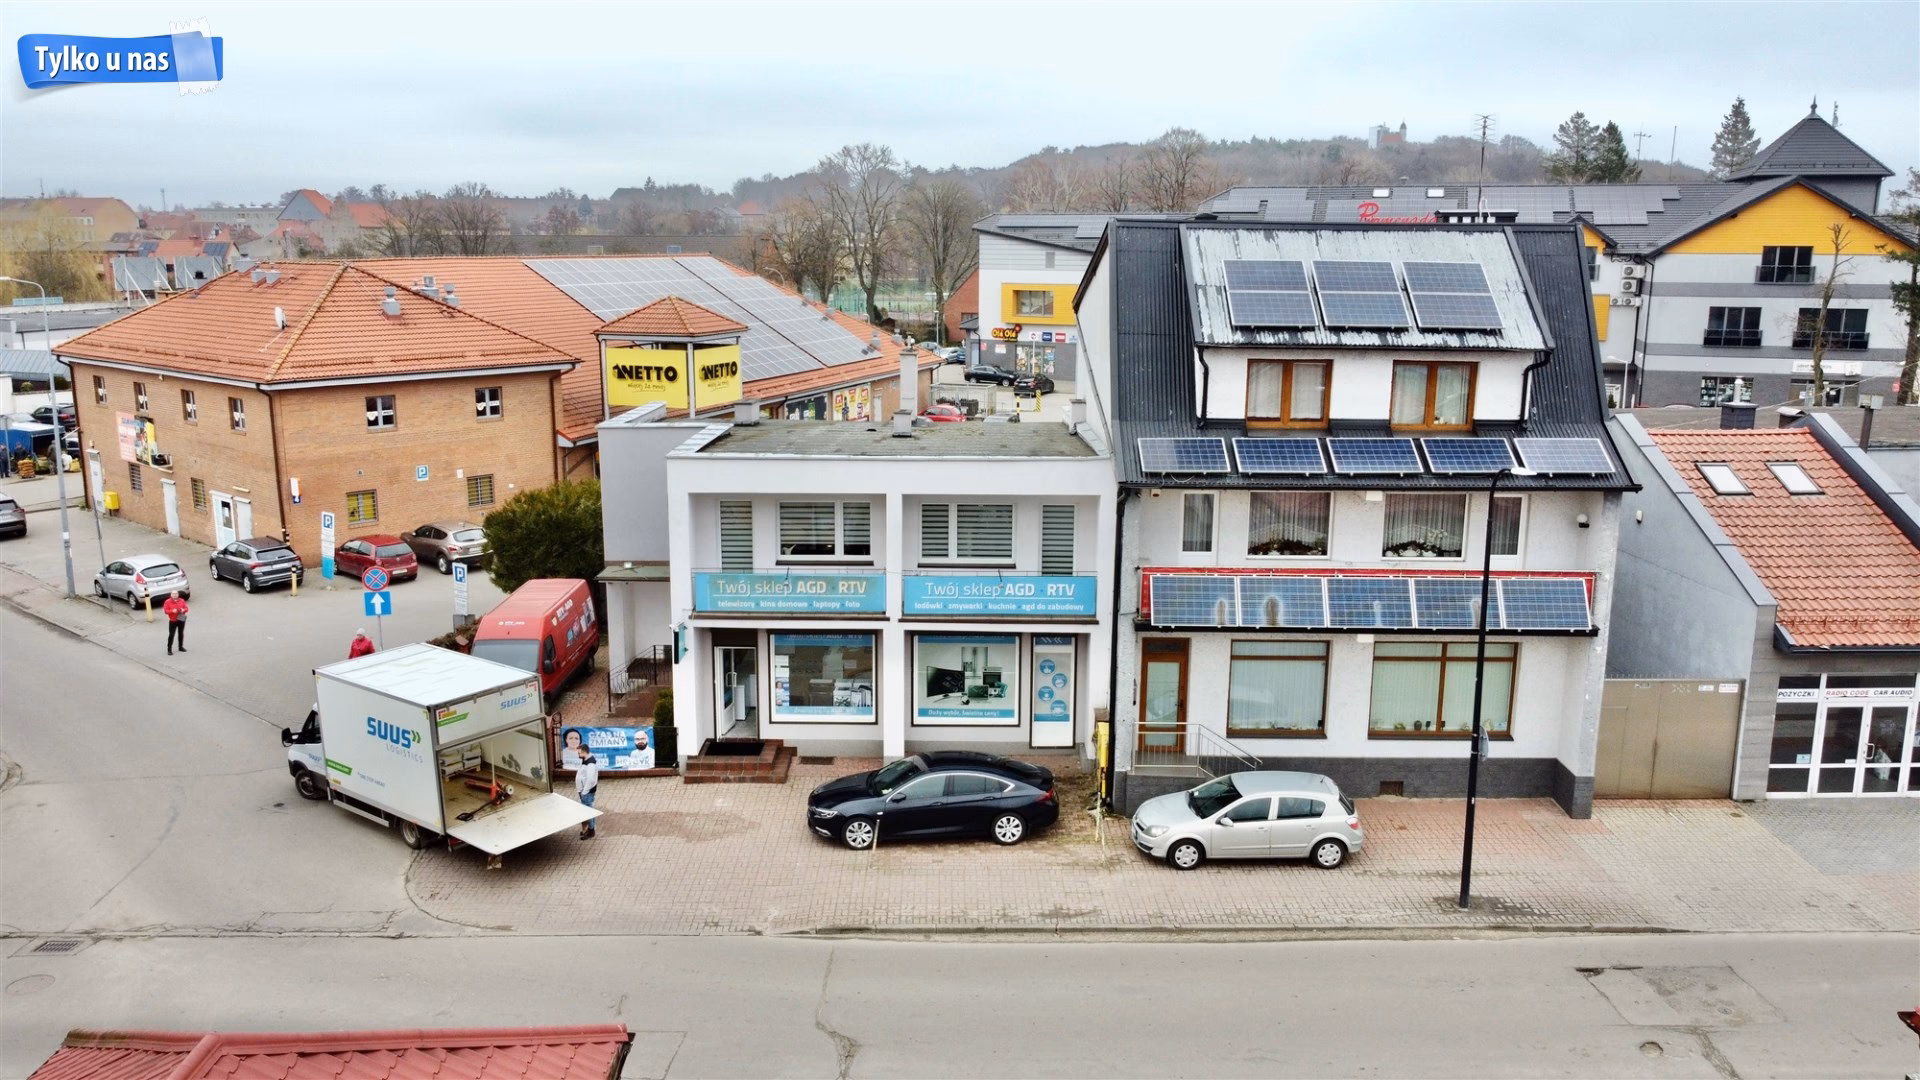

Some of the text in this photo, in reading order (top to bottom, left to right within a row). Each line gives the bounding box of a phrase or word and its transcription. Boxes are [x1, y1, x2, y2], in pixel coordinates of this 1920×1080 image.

[615, 364, 678, 382] NETTO
[702, 361, 738, 380] NETTO
[718, 580, 867, 597] Twój sklep AGD RTV
[925, 582, 1075, 599] Twój sklep AGD RTV
[718, 601, 755, 609] telewizory
[813, 601, 840, 609] laptopy
[947, 603, 983, 611] zmywarki
[988, 602, 1016, 610] kuchnie
[1021, 603, 1035, 611] agd
[1047, 603, 1084, 611] zabudowy
[500, 695, 529, 710] SUUS
[367, 716, 411, 749] SUUS
[590, 738, 625, 747] ZMIANY
[386, 744, 424, 763] LOGISTICS
